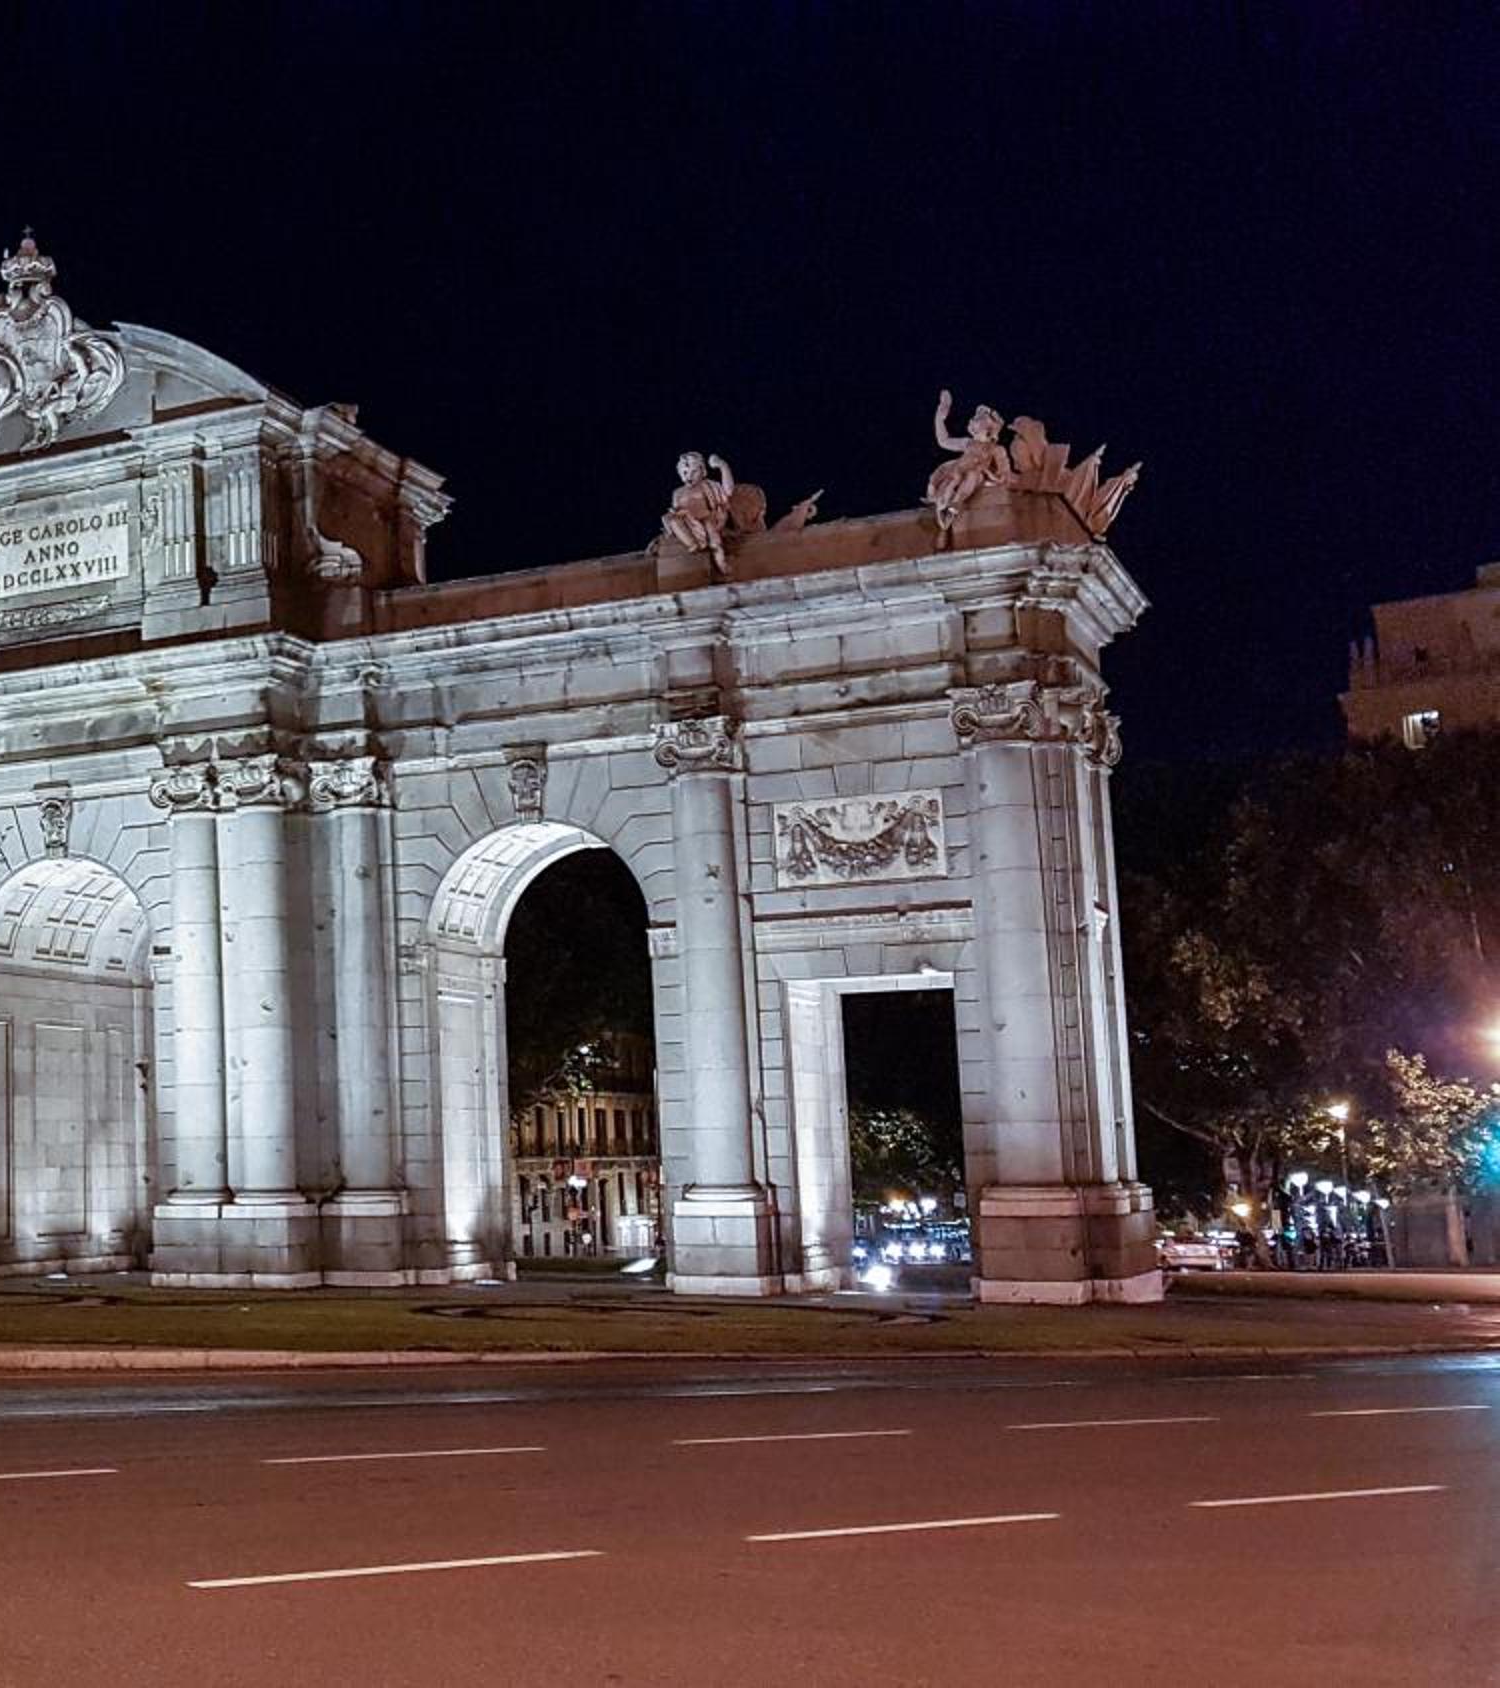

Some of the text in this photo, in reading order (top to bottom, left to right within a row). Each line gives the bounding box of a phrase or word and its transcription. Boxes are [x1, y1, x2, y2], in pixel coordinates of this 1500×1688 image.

[28, 515, 102, 542] CAROLO
[107, 510, 129, 527] III
[23, 541, 80, 565] ANNO
